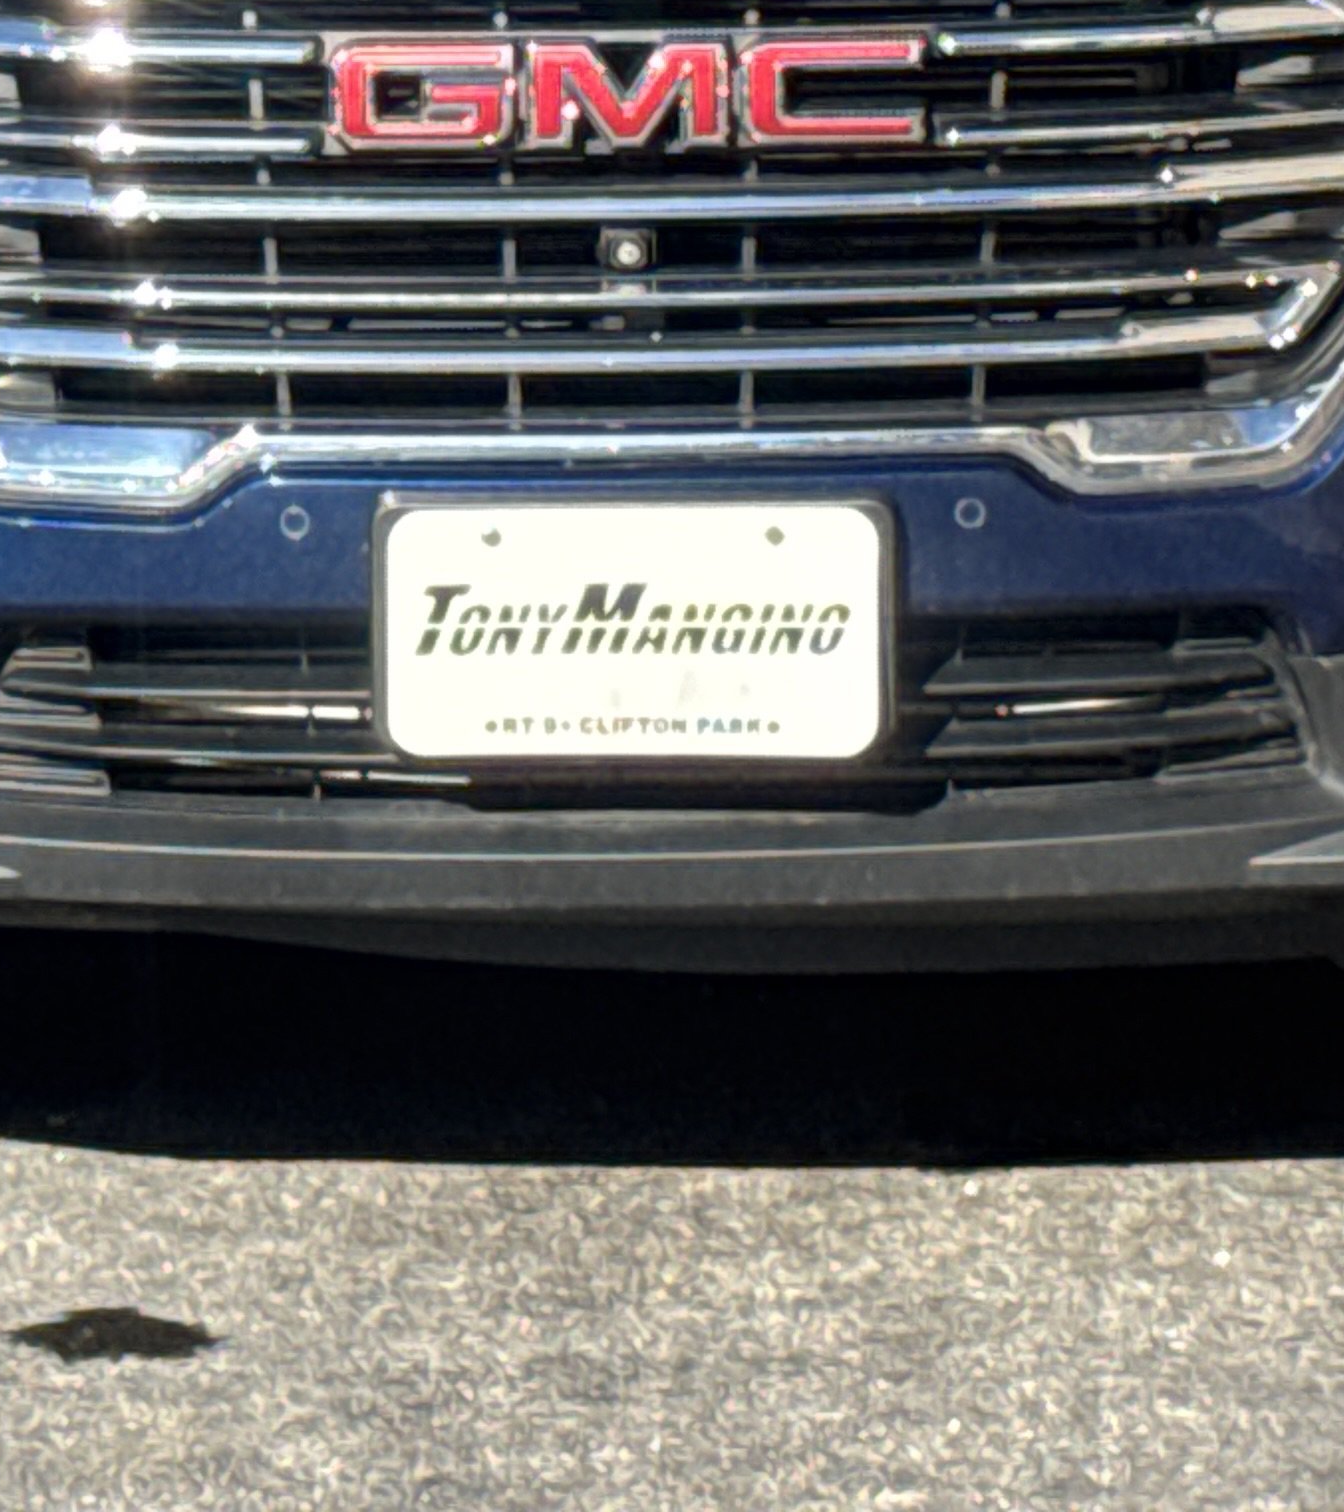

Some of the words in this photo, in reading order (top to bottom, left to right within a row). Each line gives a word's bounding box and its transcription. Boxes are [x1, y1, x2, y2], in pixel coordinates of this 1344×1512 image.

[333, 38, 929, 150] GMC
[579, 716, 687, 735] CLIFTON
[696, 716, 761, 735] PARK
